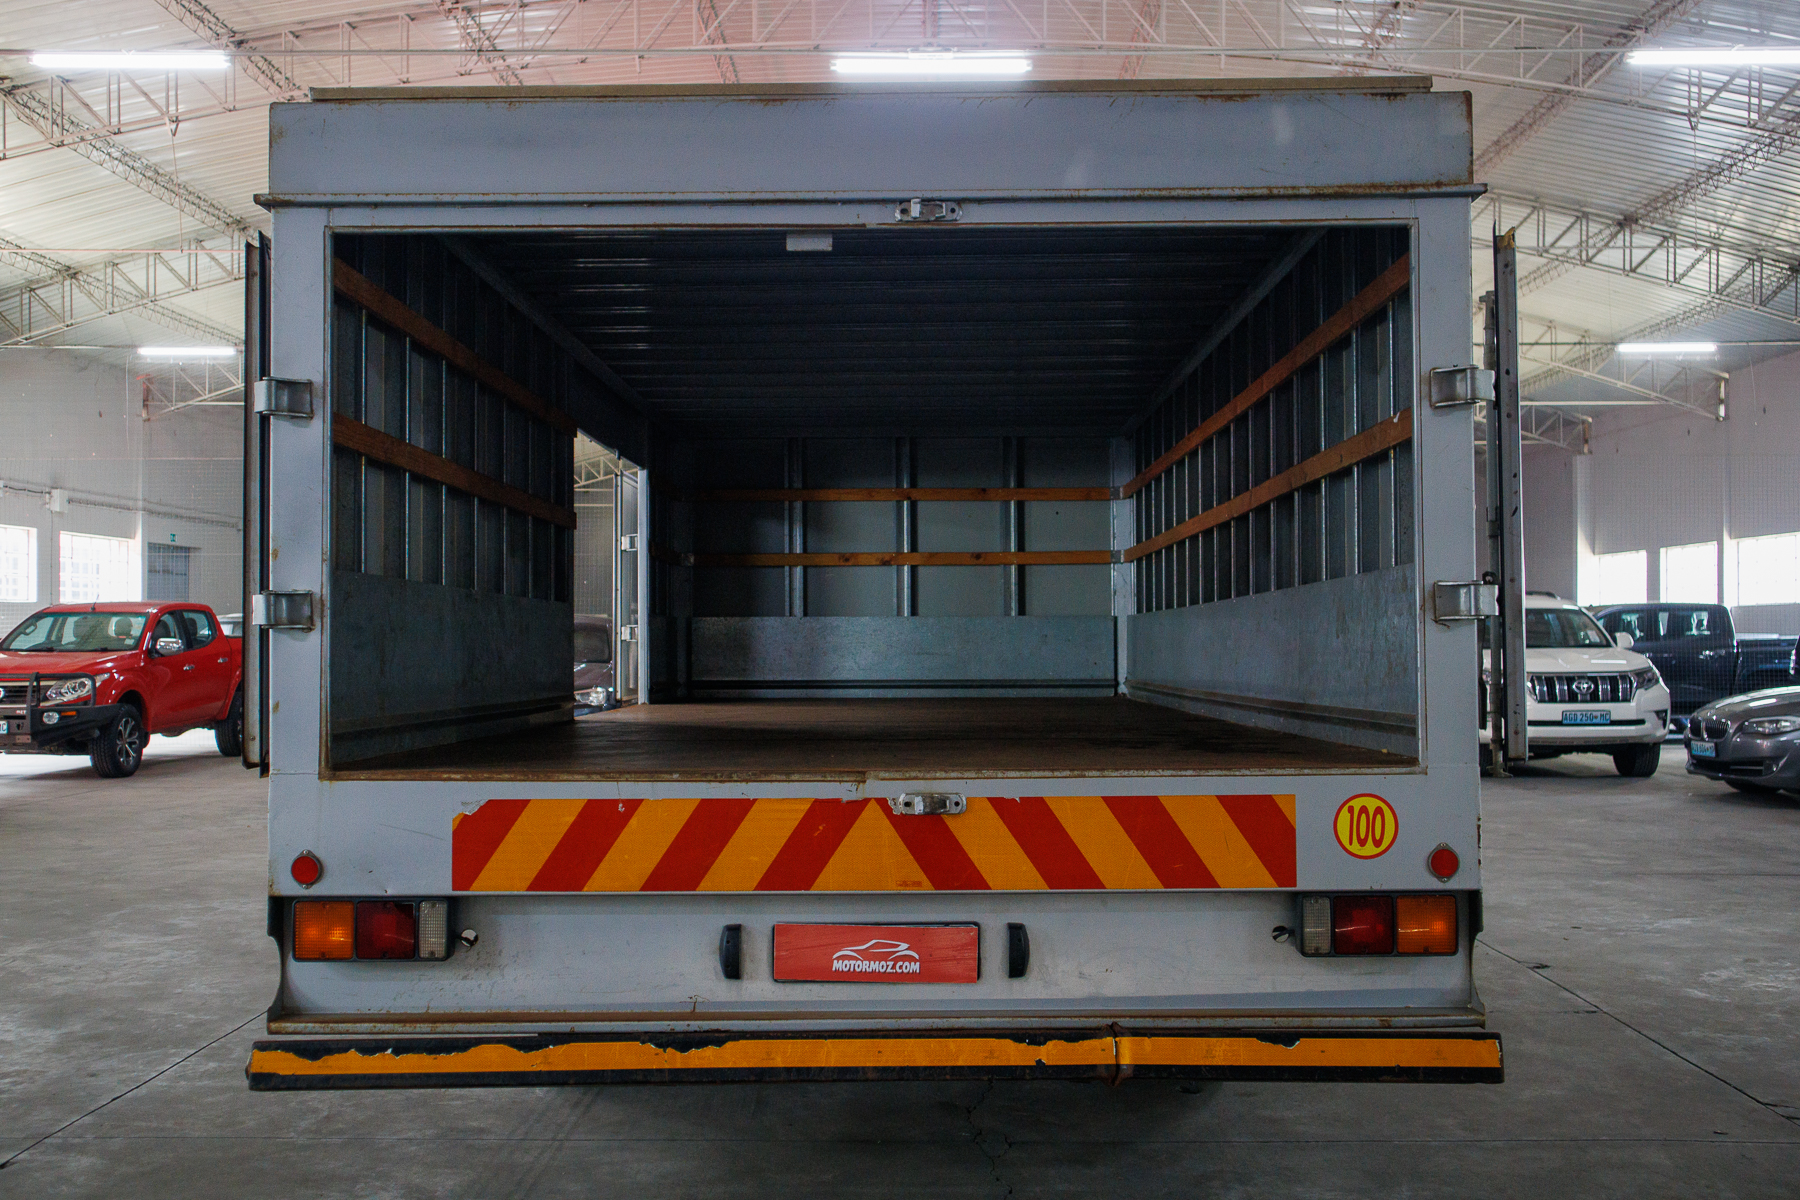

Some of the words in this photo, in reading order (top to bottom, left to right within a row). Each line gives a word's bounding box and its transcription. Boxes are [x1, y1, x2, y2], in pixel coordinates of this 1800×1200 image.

[1580, 712, 1594, 722] 250
[1600, 712, 1610, 722] MC
[1347, 804, 1386, 849] 100
[832, 959, 920, 974] MOTORMOZ.COM
